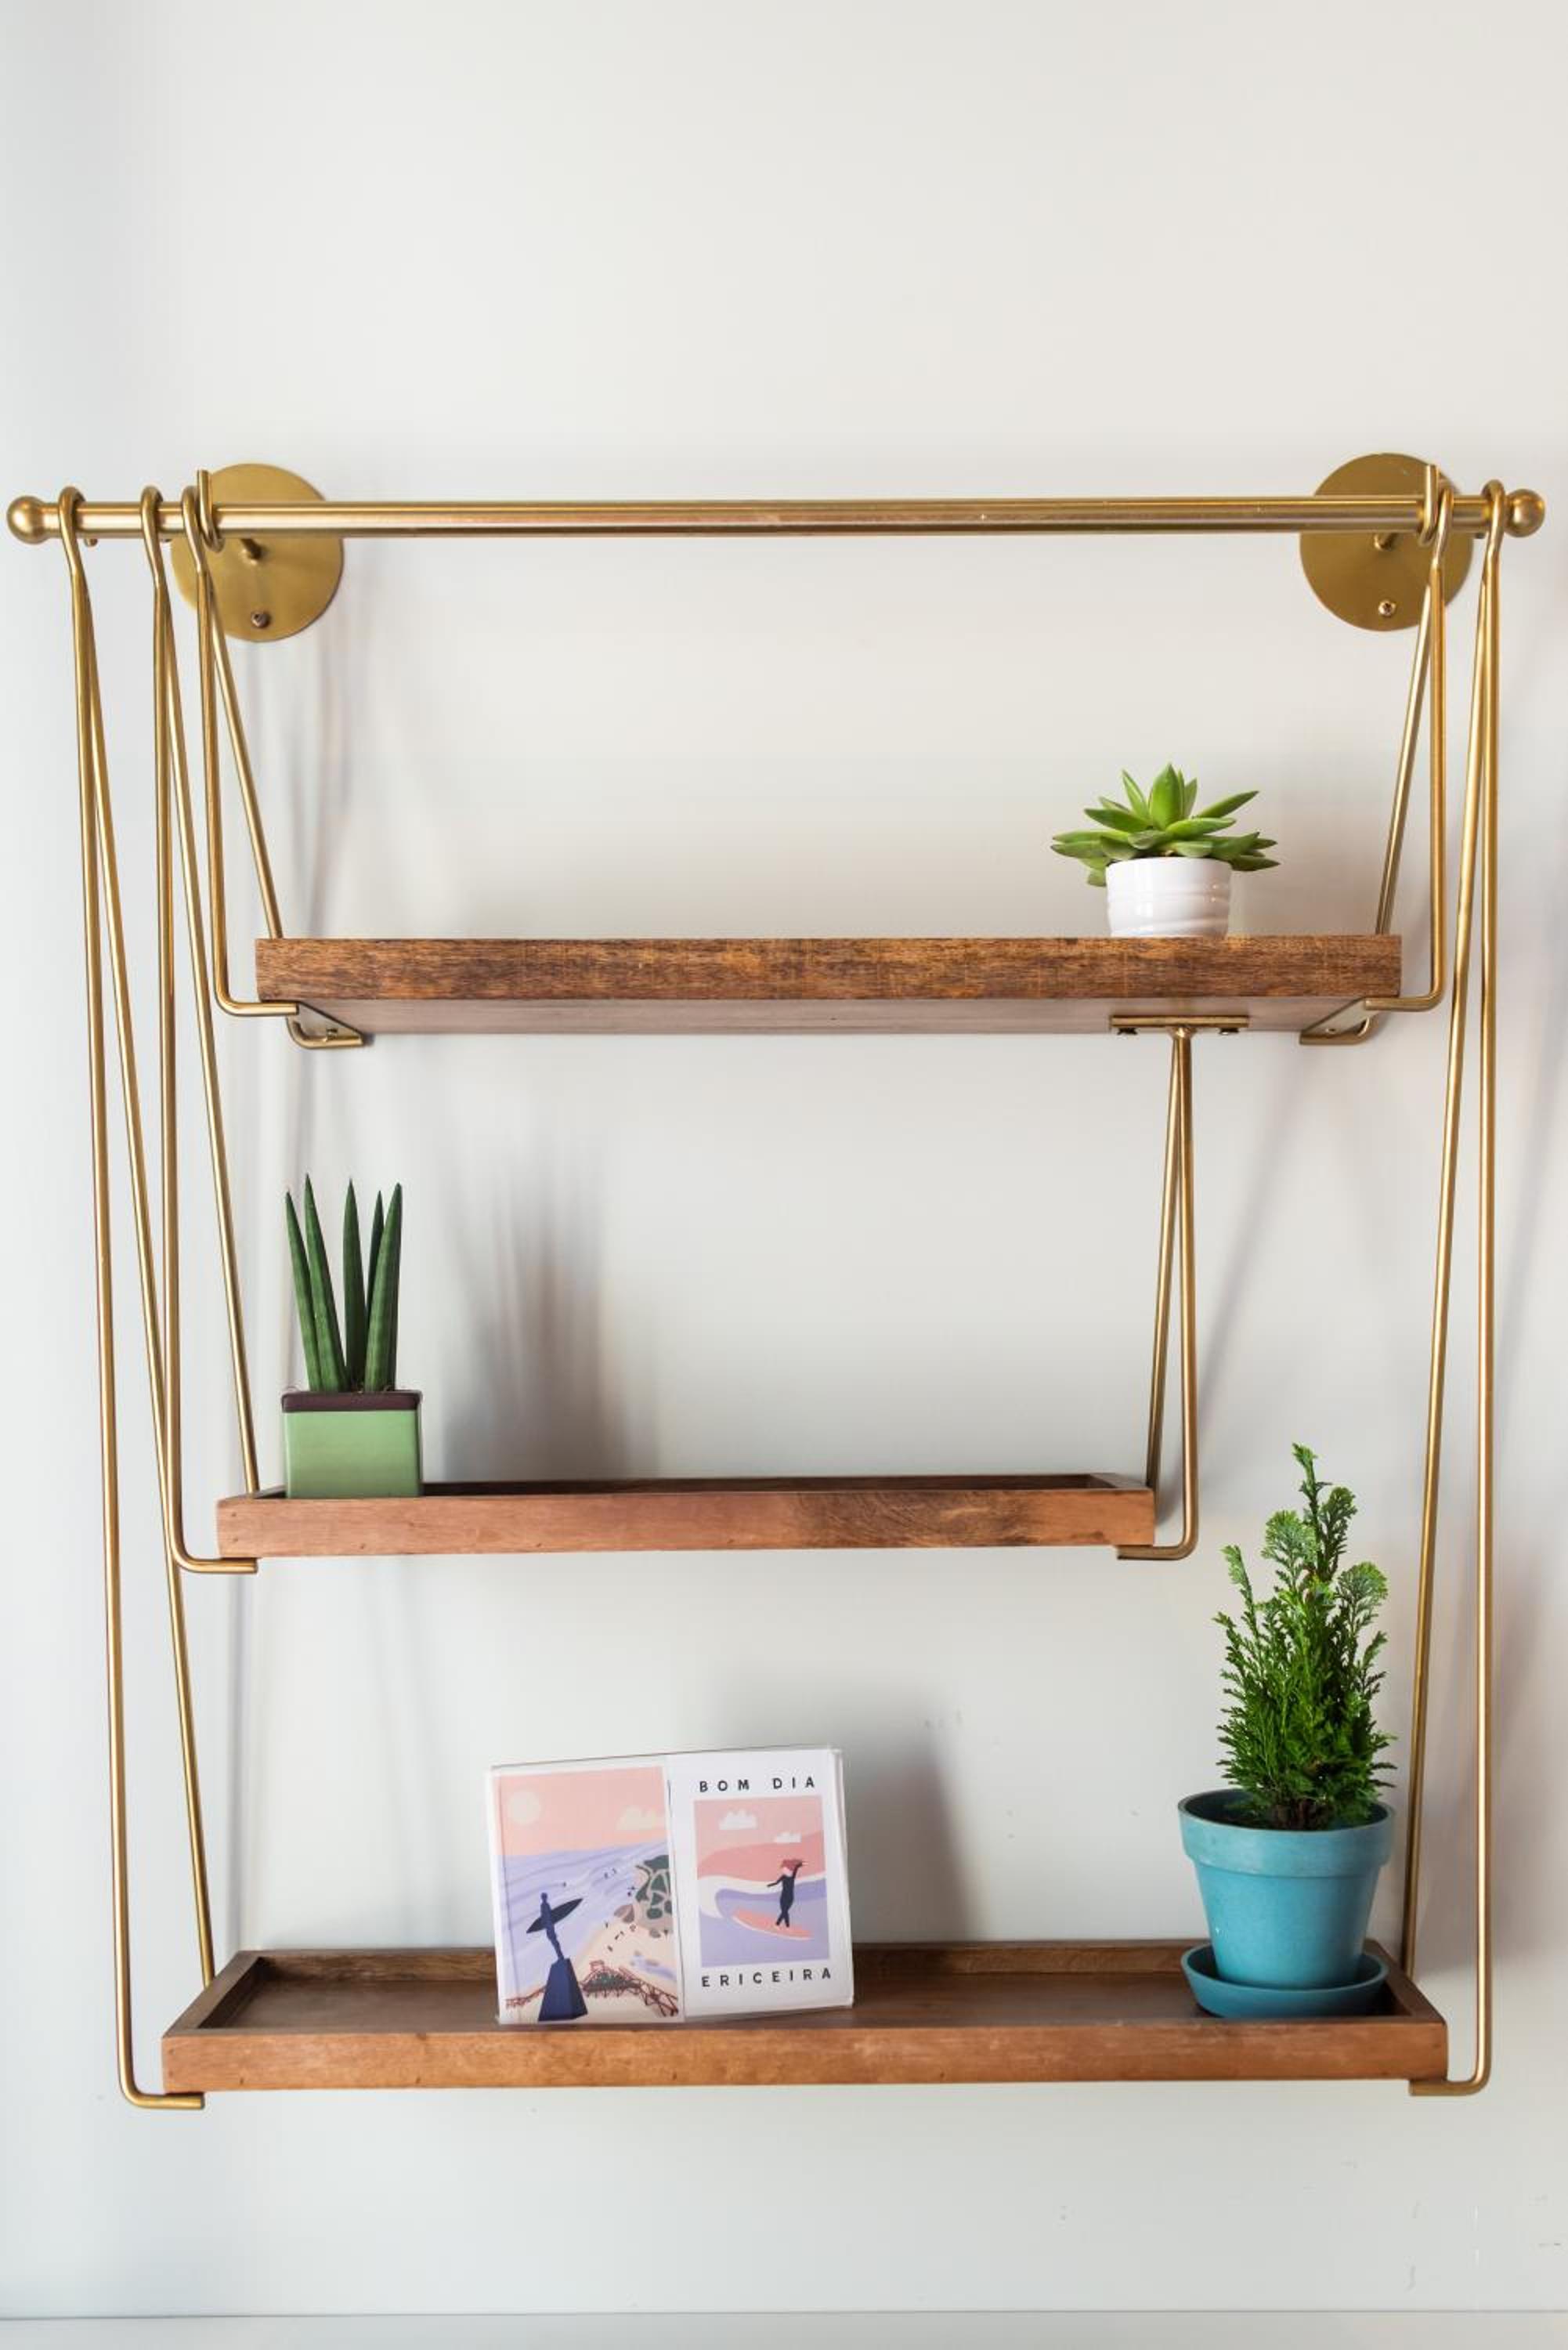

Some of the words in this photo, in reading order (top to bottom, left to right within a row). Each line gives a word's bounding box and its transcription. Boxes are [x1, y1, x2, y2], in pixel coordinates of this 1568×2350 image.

[699, 1779, 750, 1793] BOM
[772, 1776, 815, 1789] DIA
[702, 1968, 831, 1987] ERICEIRA
